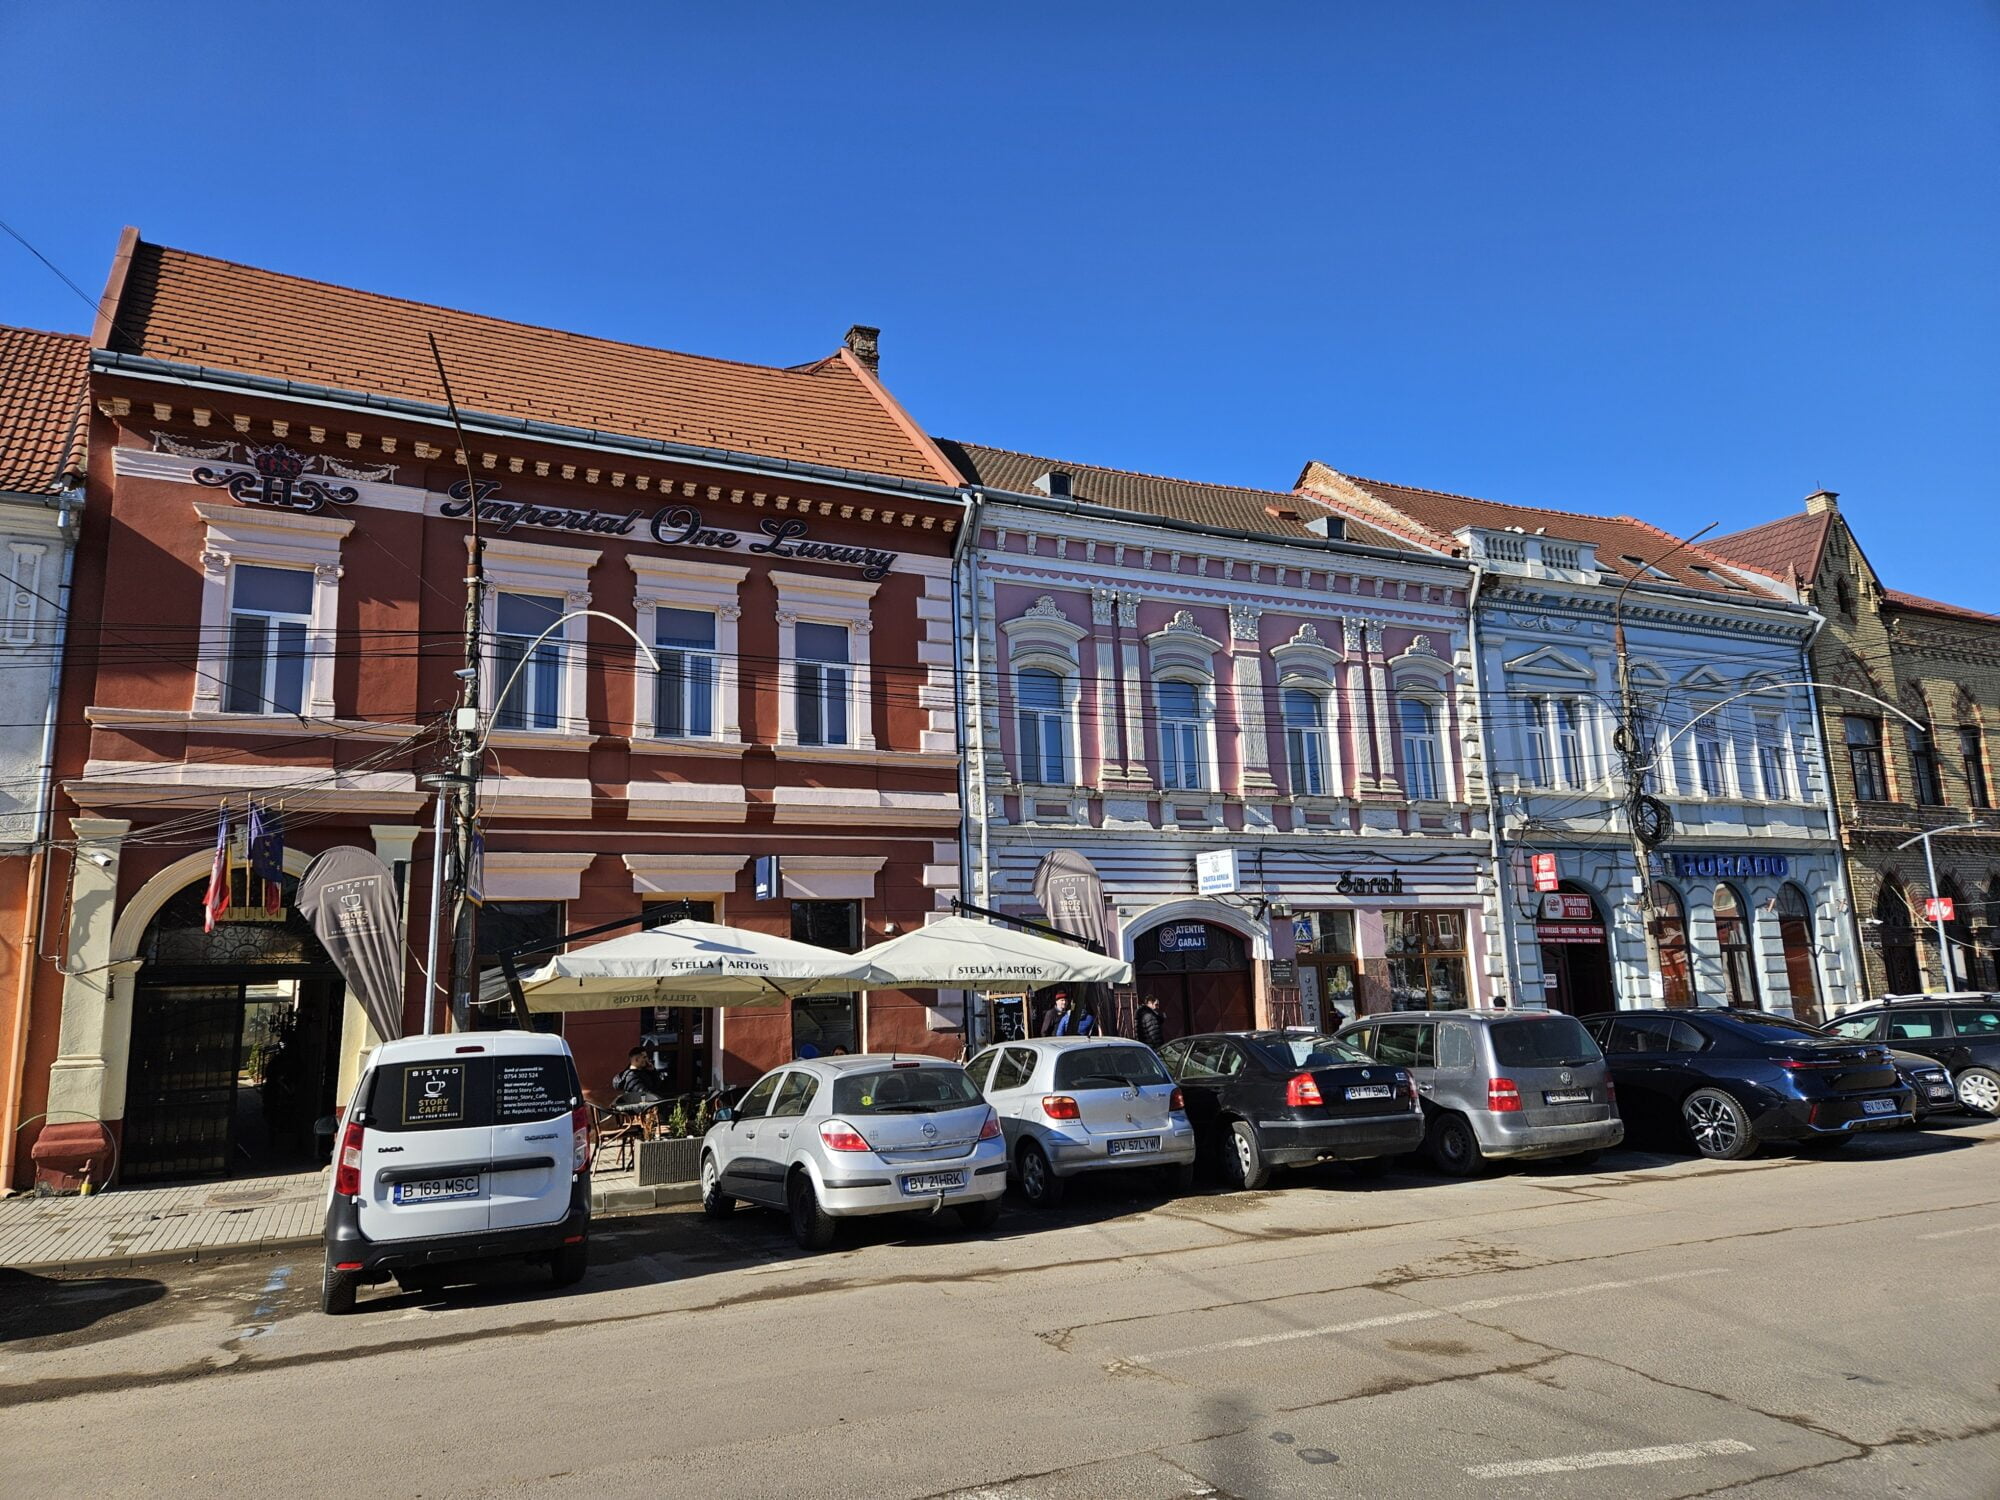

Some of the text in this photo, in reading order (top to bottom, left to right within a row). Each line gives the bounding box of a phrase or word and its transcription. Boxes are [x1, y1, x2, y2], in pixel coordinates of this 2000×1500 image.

[439, 478, 899, 581] Imperial One Luxury
[1336, 868, 1403, 893] Sarah
[671, 960, 769, 971] STELLA ARTOIS
[958, 966, 1042, 975] STELLA ARTOIS
[412, 1068, 459, 1077] BISTRO
[1350, 1087, 1361, 1098] BV
[418, 1098, 449, 1107] STORY
[418, 1105, 448, 1114] CAFFE
[1113, 1141, 1126, 1151] BV
[403, 1178, 475, 1198] B 169 MSC
[909, 1177, 924, 1190] BV
